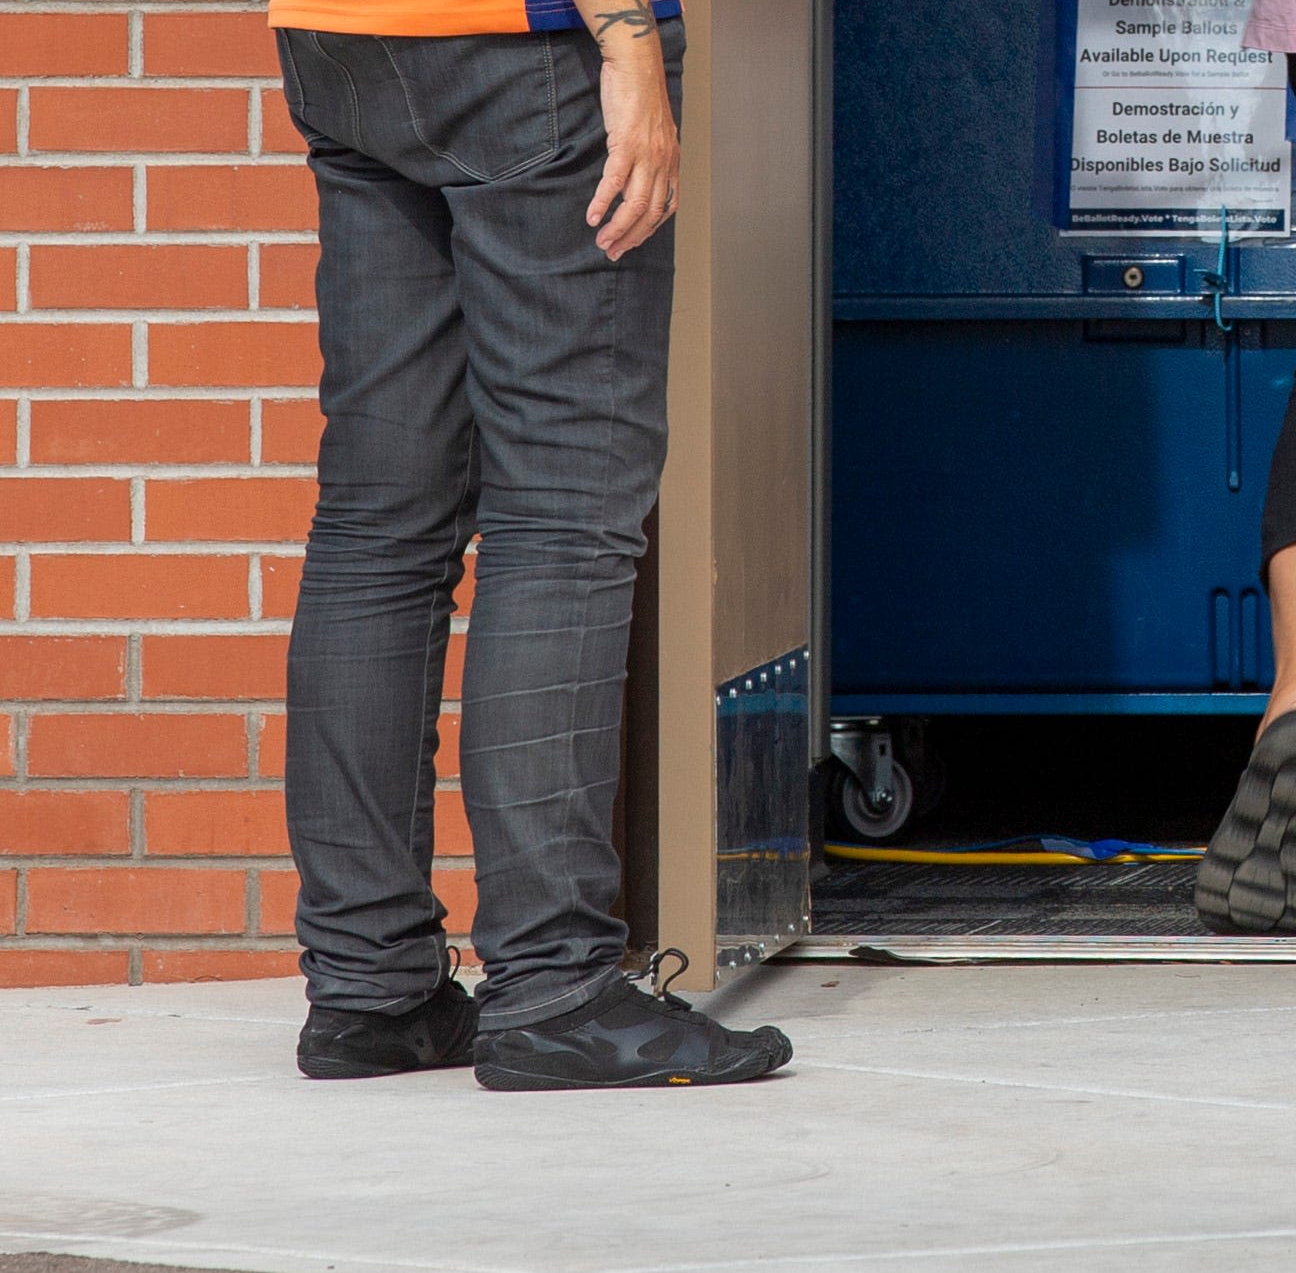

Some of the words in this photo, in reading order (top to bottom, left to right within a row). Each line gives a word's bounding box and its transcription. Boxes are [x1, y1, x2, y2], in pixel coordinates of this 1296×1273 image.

[1115, 20, 1177, 38] Sample
[1181, 20, 1238, 35] Ballots
[1079, 48, 1154, 63] Available
[1159, 49, 1201, 66] Upon
[1206, 48, 1273, 67] Request
[1112, 101, 1225, 116] Demostración
[1229, 105, 1239, 119] y
[1096, 129, 1157, 144] Boletas
[1162, 129, 1182, 144] de
[1187, 130, 1254, 144] Muestra
[1071, 157, 1164, 175] Disponibles
[1168, 158, 1205, 175] Bajo
[1209, 157, 1281, 172] Solicitud
